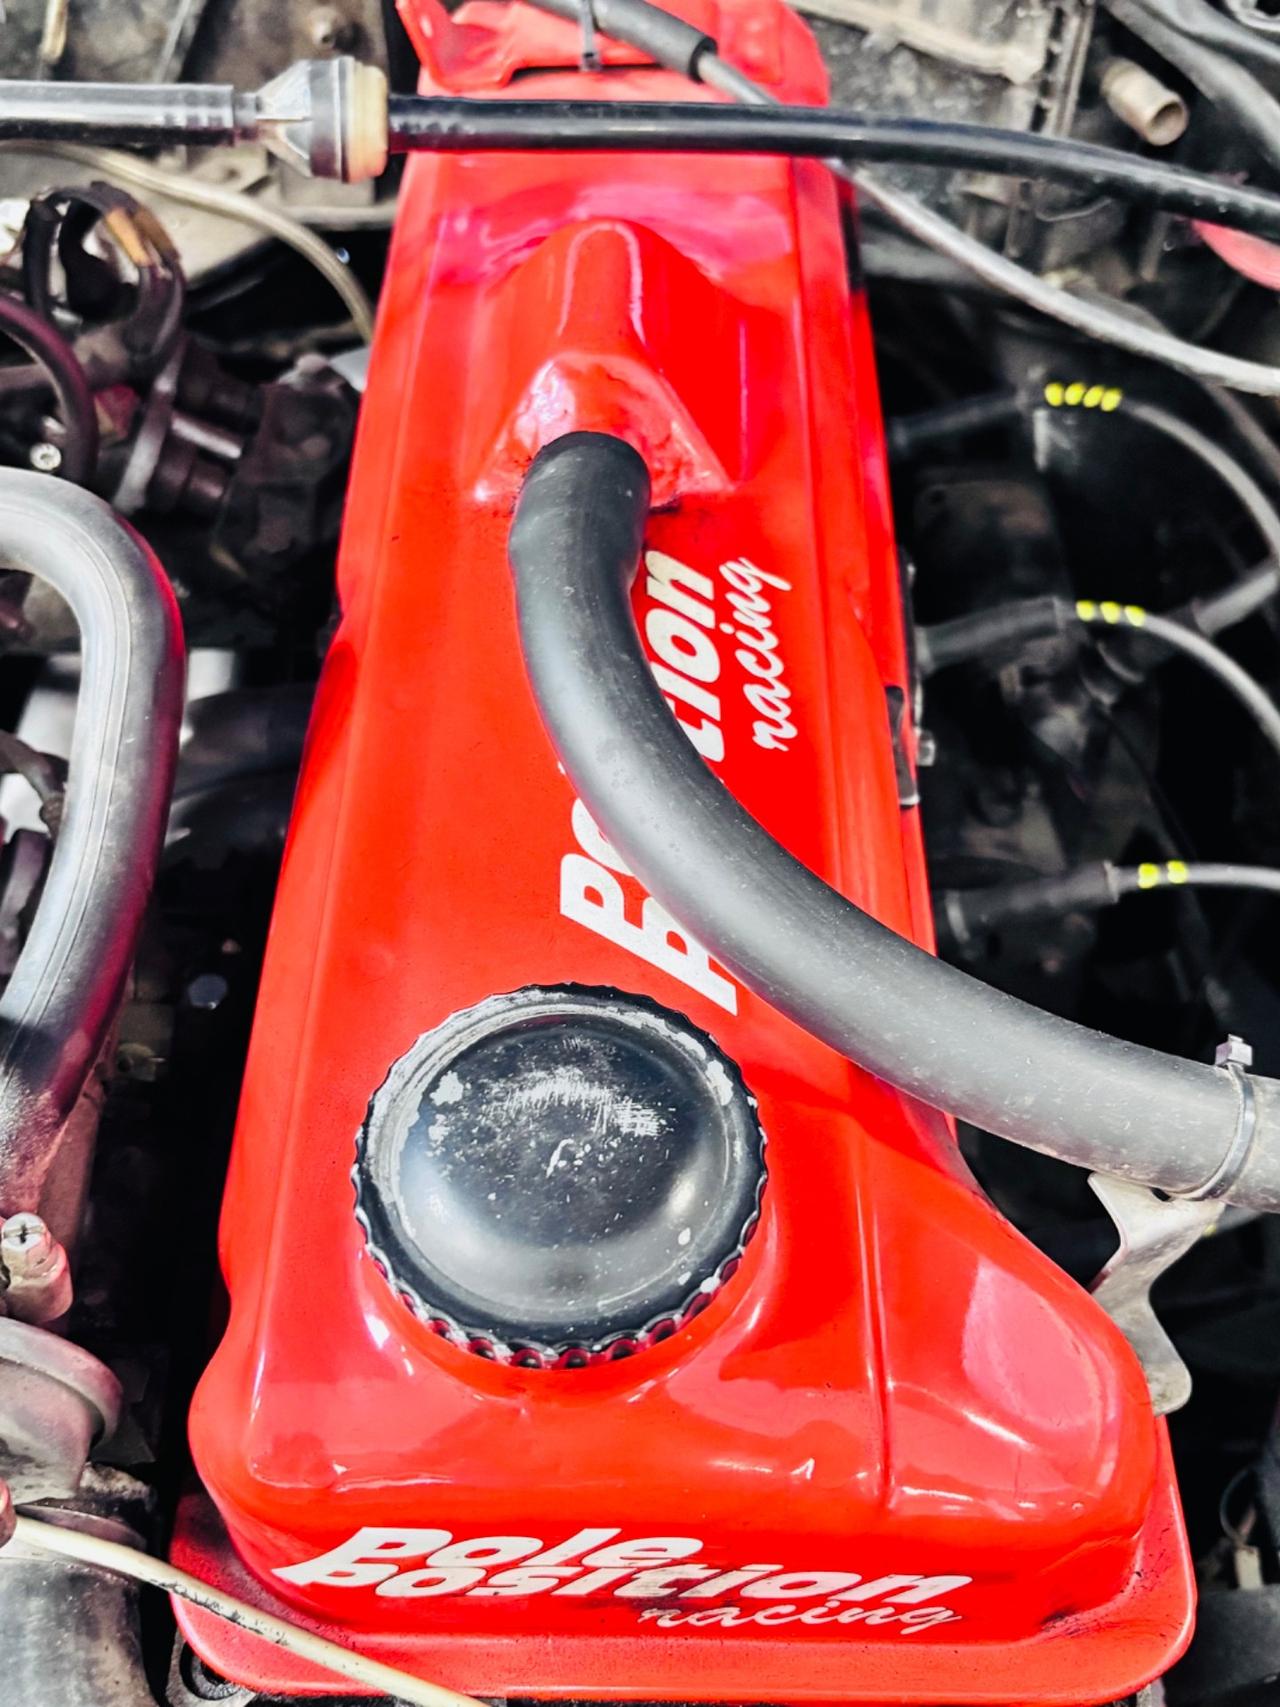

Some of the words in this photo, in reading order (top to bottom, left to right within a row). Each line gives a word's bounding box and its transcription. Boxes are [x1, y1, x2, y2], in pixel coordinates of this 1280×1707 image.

[719, 556, 798, 752] racing
[325, 1526, 704, 1568] Pole
[637, 1600, 963, 1635] racing
